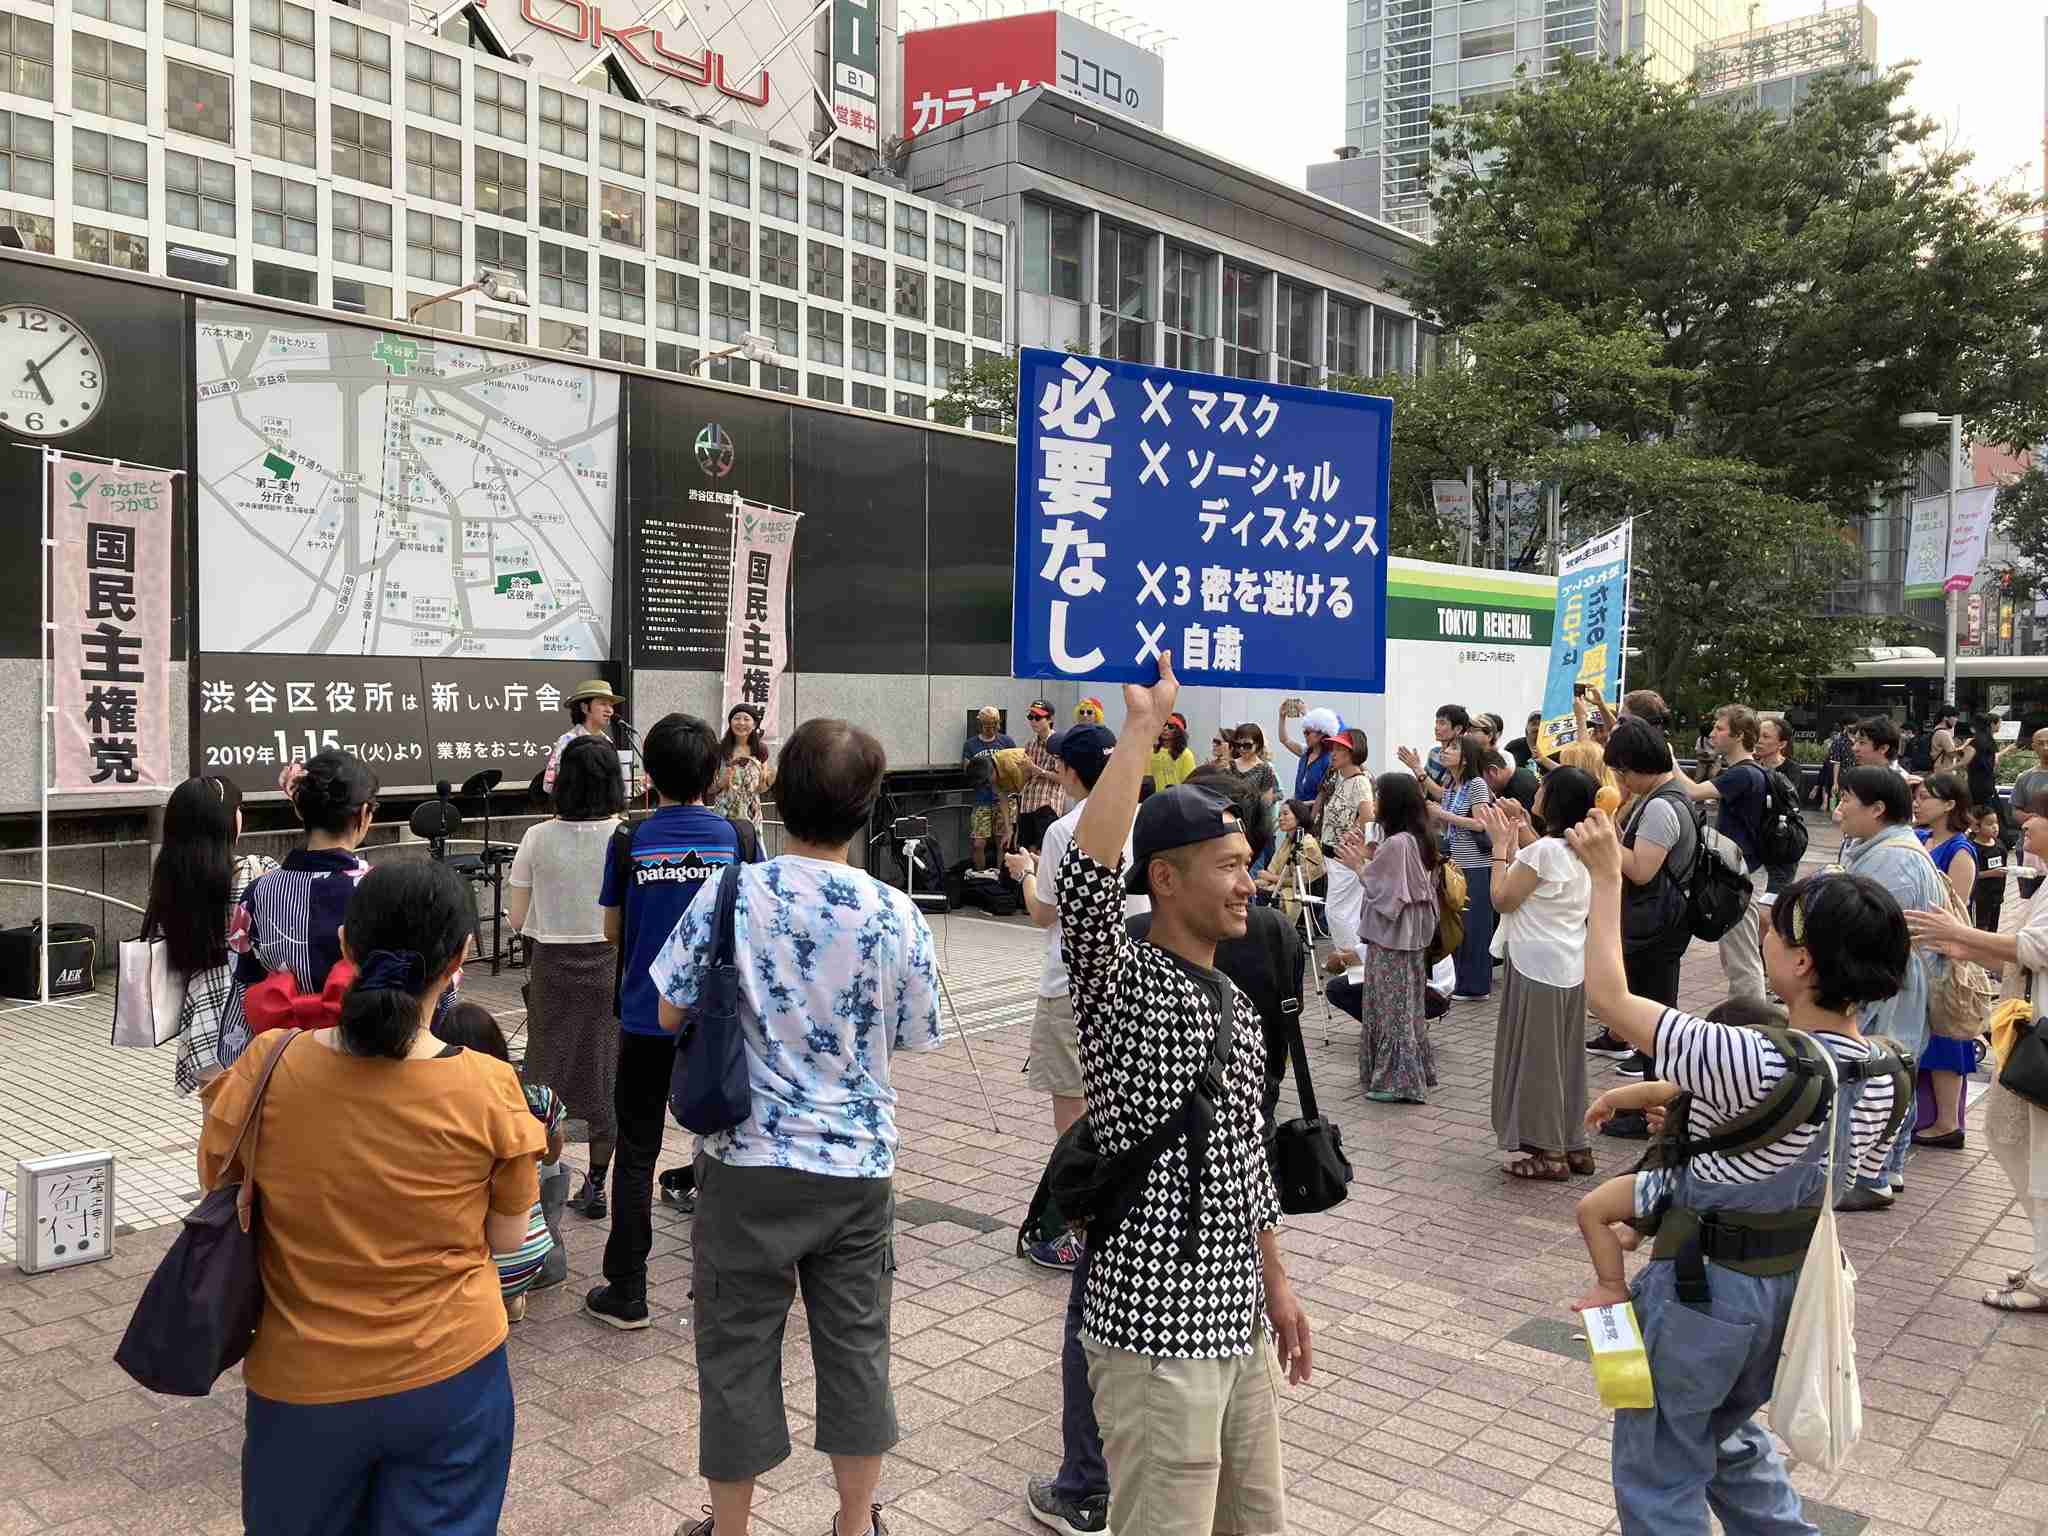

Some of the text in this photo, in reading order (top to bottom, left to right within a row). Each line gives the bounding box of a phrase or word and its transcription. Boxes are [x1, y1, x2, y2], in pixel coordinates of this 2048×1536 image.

[474, 0, 769, 107] OKYU
[847, 70, 864, 89] B1
[1060, 50, 1139, 109] ココロの
[911, 80, 1034, 135] カラオ
[836, 105, 875, 133] 営業中
[17, 311, 48, 332] 12
[79, 370, 98, 389] 3
[484, 379, 529, 393] SHIBUYA109
[523, 373, 556, 385] TSUTAYA
[564, 380, 583, 391] EAST
[25, 412, 44, 431] 6
[1187, 388, 1279, 438] マスク
[1187, 448, 1340, 502] ソーシャル
[99, 479, 163, 497] あなたと
[256, 479, 301, 492] 第二美竹
[110, 497, 160, 512] つかむ
[261, 492, 295, 504] 分庁舎
[374, 510, 385, 519] JR
[1038, 357, 1116, 674] 必要なし
[1198, 497, 1380, 556] ディスタンス
[511, 578, 530, 590] 渋谷
[506, 589, 533, 601] 区役所
[1437, 607, 1532, 640] TOKYU RENEWAL
[80, 522, 144, 784] 国民主権党
[1183, 622, 1244, 671] 自粛
[437, 740, 557, 760] 業務をおこなっ
[636, 864, 724, 886] patagoni
